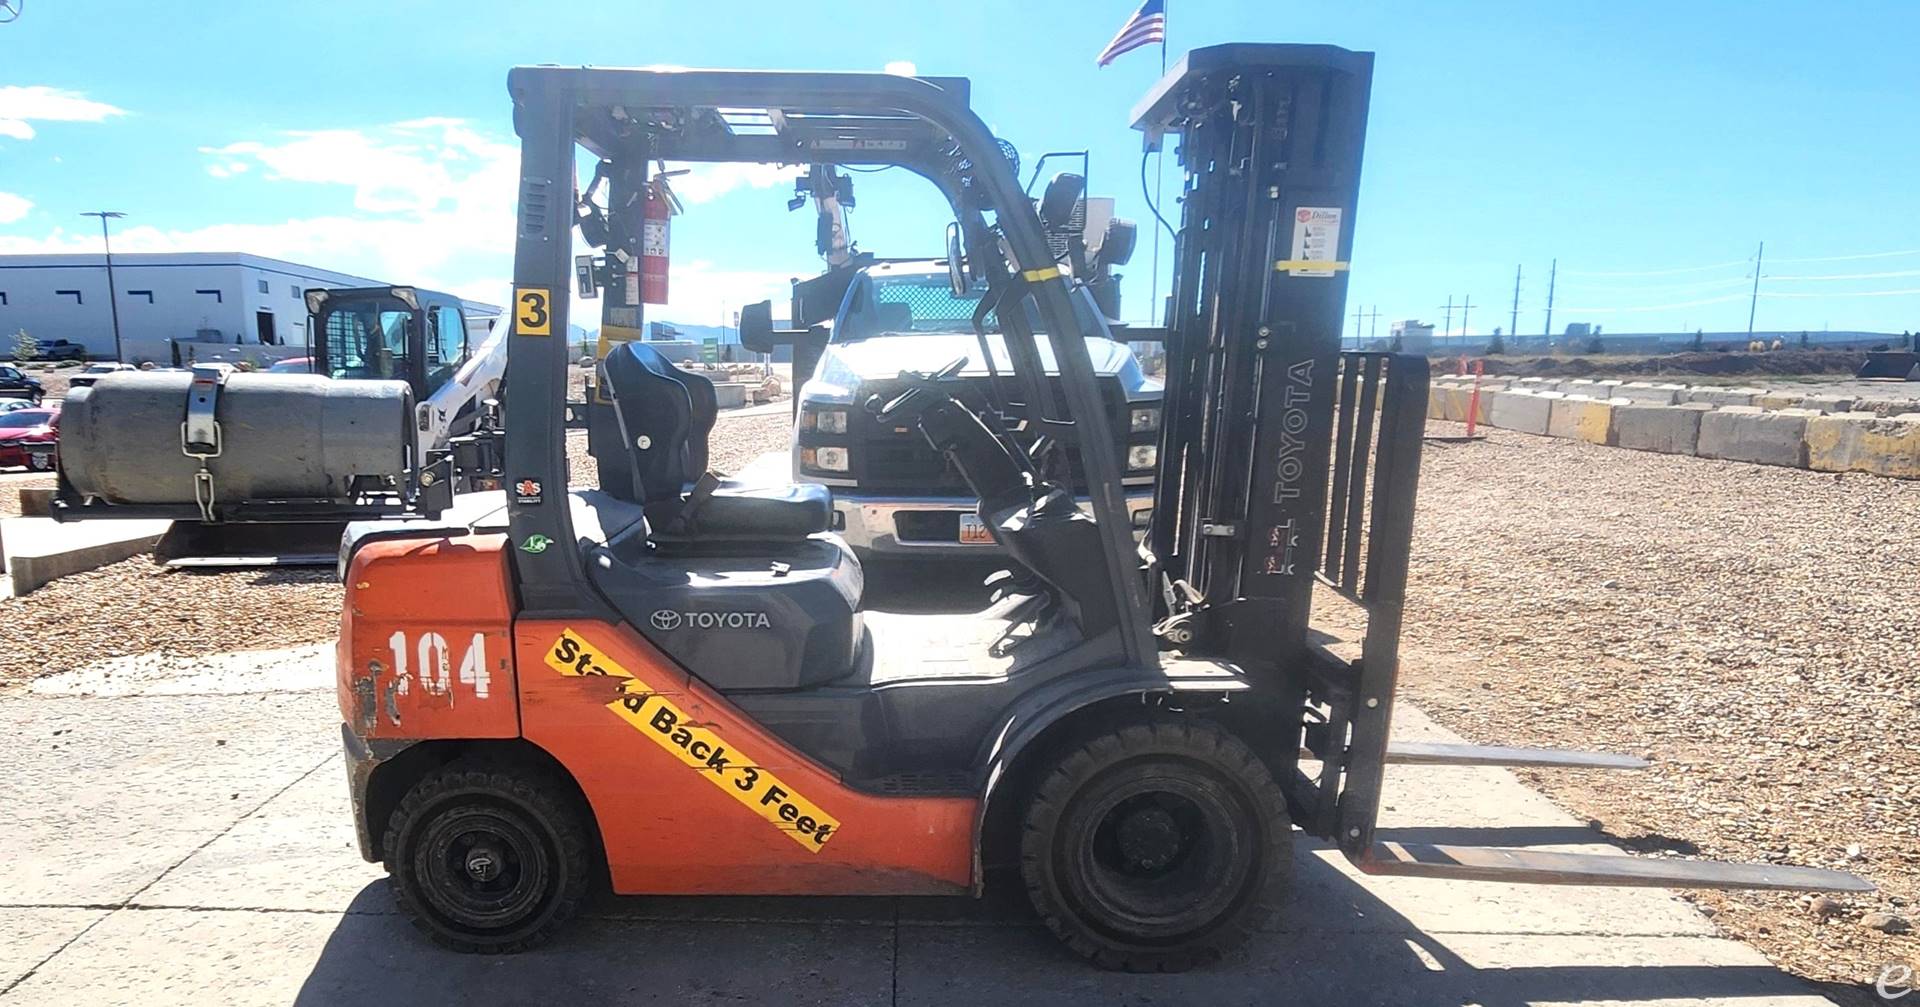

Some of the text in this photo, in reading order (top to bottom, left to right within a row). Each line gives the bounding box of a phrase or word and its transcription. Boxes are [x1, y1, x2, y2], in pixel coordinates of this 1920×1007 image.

[521, 293, 547, 328] 3
[1274, 359, 1315, 504] TOYOTA
[516, 480, 541, 496] SAS
[685, 612, 771, 628] TOYOTA
[389, 631, 491, 698] 104
[555, 638, 832, 845] Std Back 3 Feet
